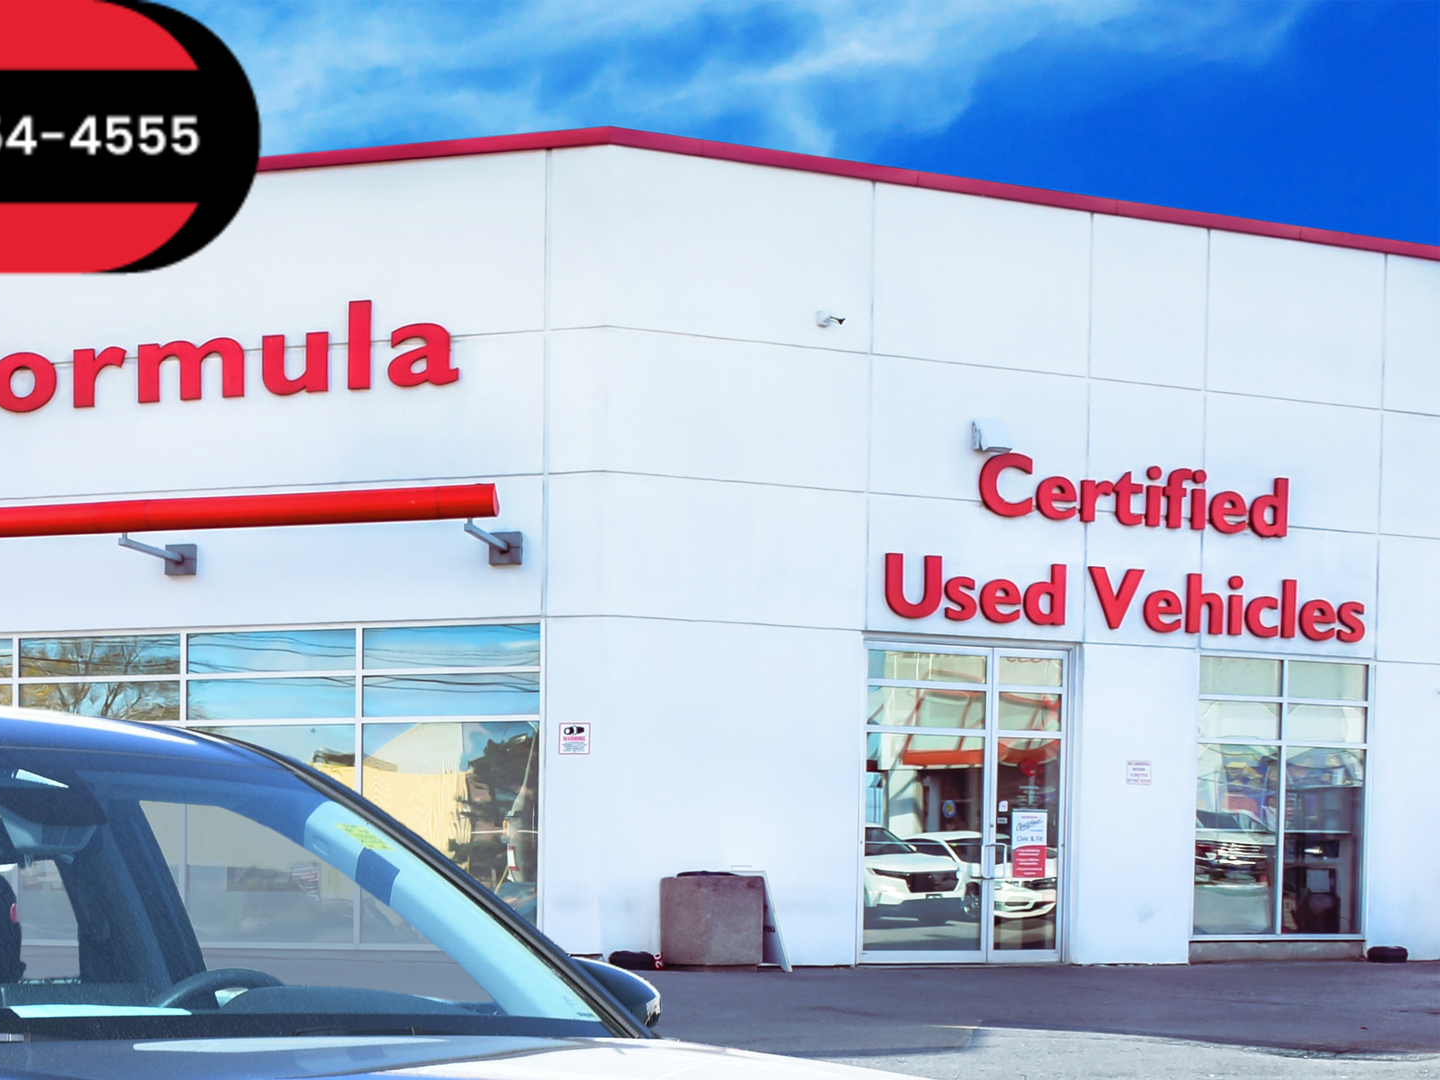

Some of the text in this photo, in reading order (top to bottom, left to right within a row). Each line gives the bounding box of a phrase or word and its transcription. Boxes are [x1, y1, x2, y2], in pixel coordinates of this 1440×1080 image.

[978, 452, 1290, 538] Certified
[884, 552, 1366, 643] Used Vehicles
